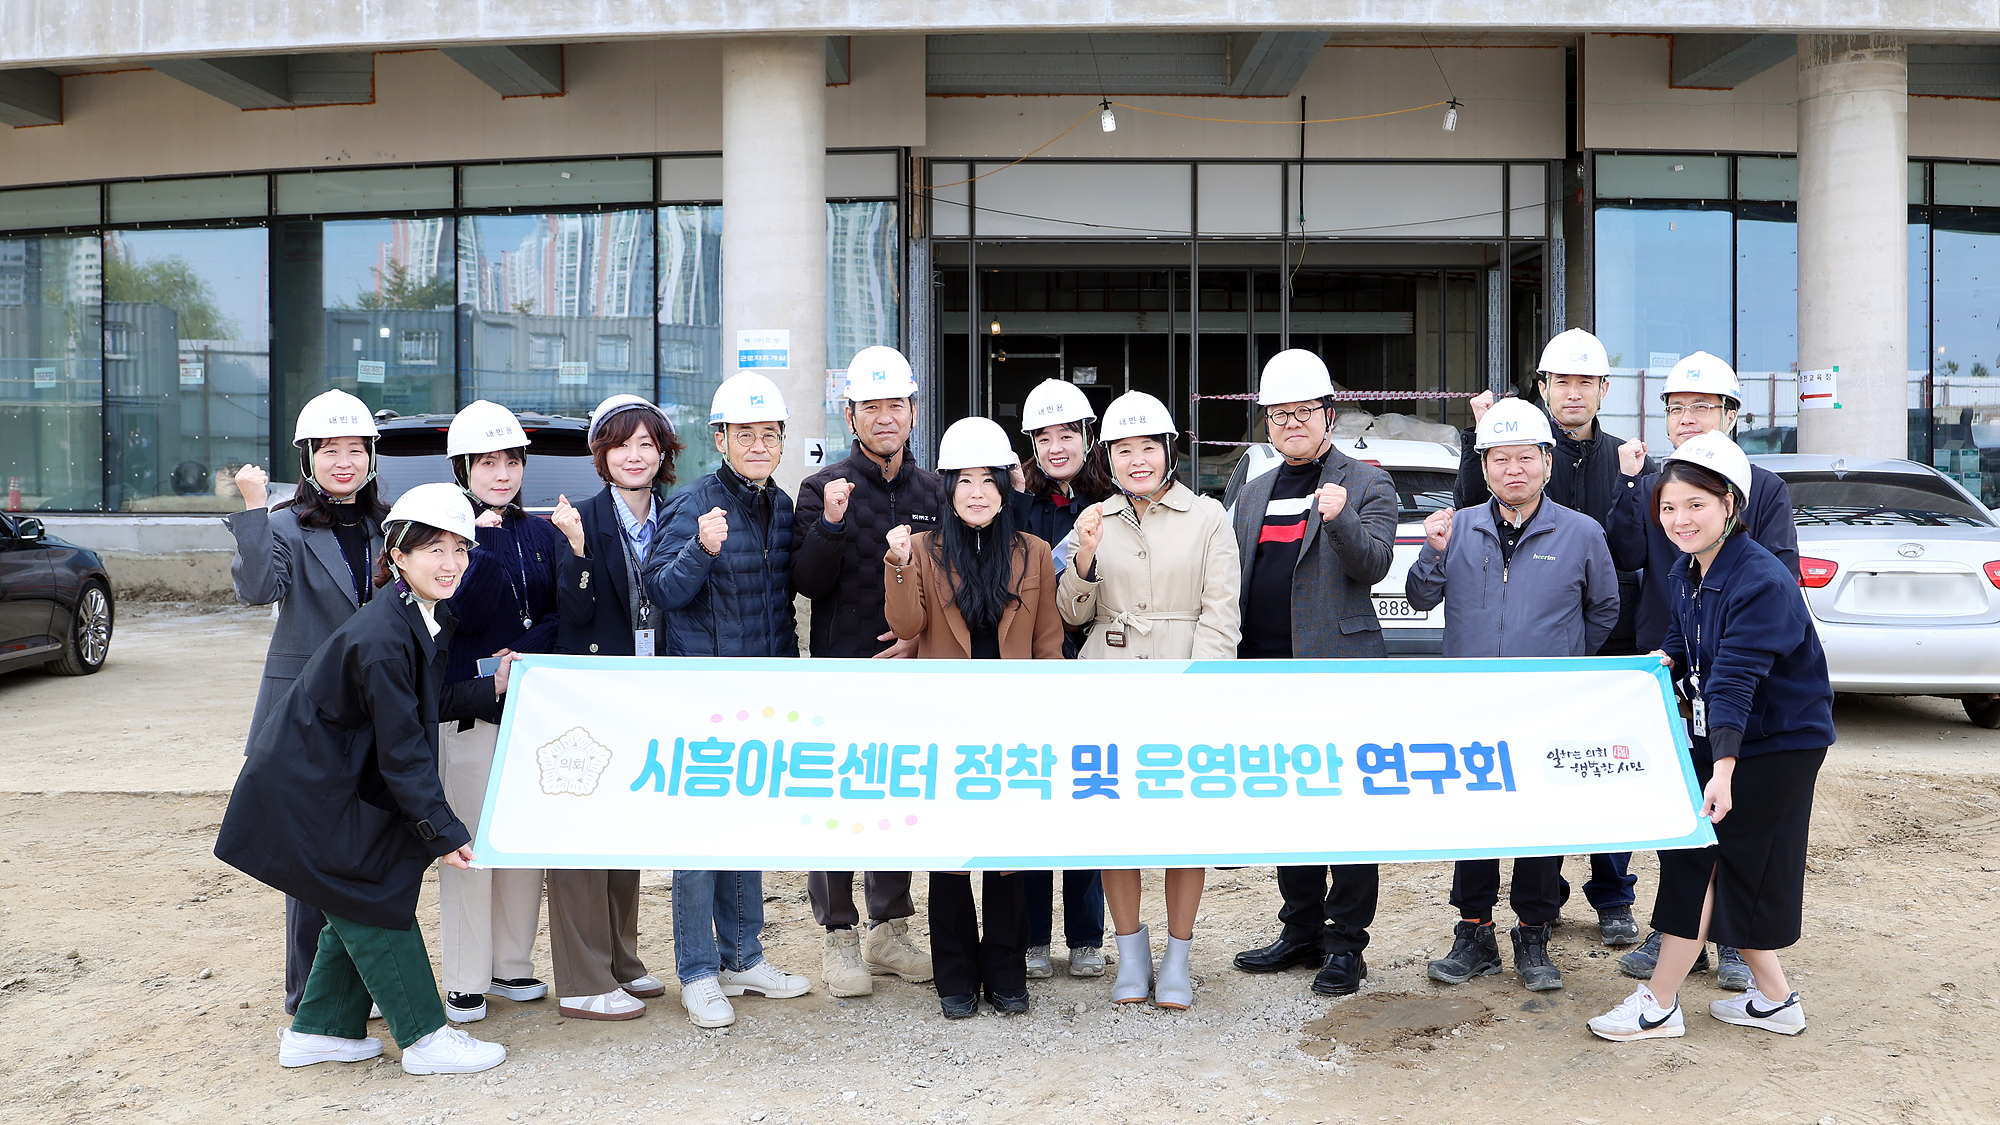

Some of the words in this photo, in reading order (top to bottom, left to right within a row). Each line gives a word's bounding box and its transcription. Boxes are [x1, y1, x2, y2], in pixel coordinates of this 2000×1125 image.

[328, 415, 359, 425] 내빈용
[1119, 415, 1147, 425] 내빈용
[485, 426, 513, 438] 내빈용
[1493, 421, 1518, 434] CM
[1532, 553, 1557, 561] heerim
[1379, 600, 1418, 616] 888
[558, 757, 586, 772] 의회
[1546, 748, 1582, 769] 일하는
[1585, 746, 1607, 758] 의회
[629, 736, 939, 800] 시흥아트센터
[953, 742, 1058, 800] 정착
[1071, 742, 1121, 800] 및
[1134, 742, 1344, 799] 운영방안
[1356, 740, 1517, 795] 연구회
[1570, 760, 1614, 778] 행복한
[1617, 761, 1645, 774] 시민
